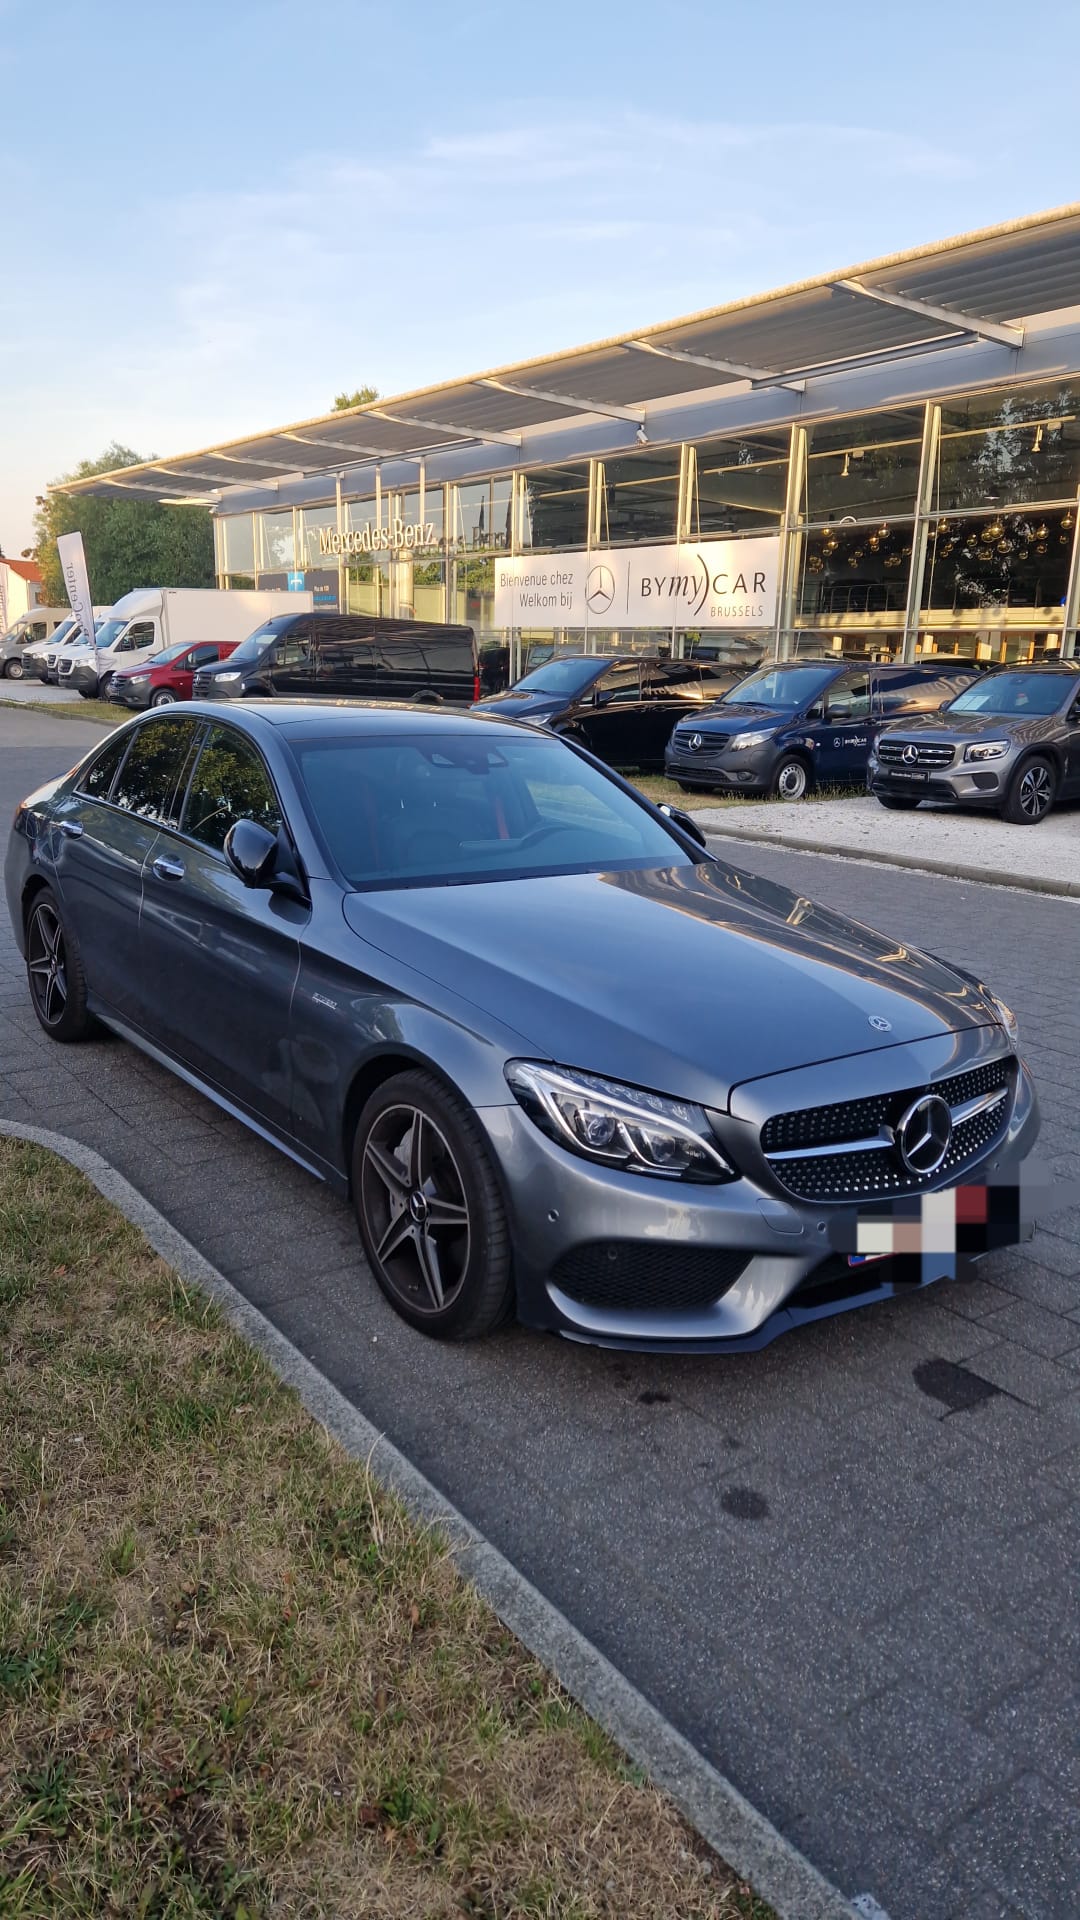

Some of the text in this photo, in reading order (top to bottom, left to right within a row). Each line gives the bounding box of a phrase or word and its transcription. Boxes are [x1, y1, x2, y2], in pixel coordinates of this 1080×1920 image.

[319, 518, 435, 555] Mercedes-Benz
[500, 570, 574, 588] Bienvenue chez
[520, 592, 573, 610] Welkom bij
[710, 605, 764, 618] BRUSSELS
